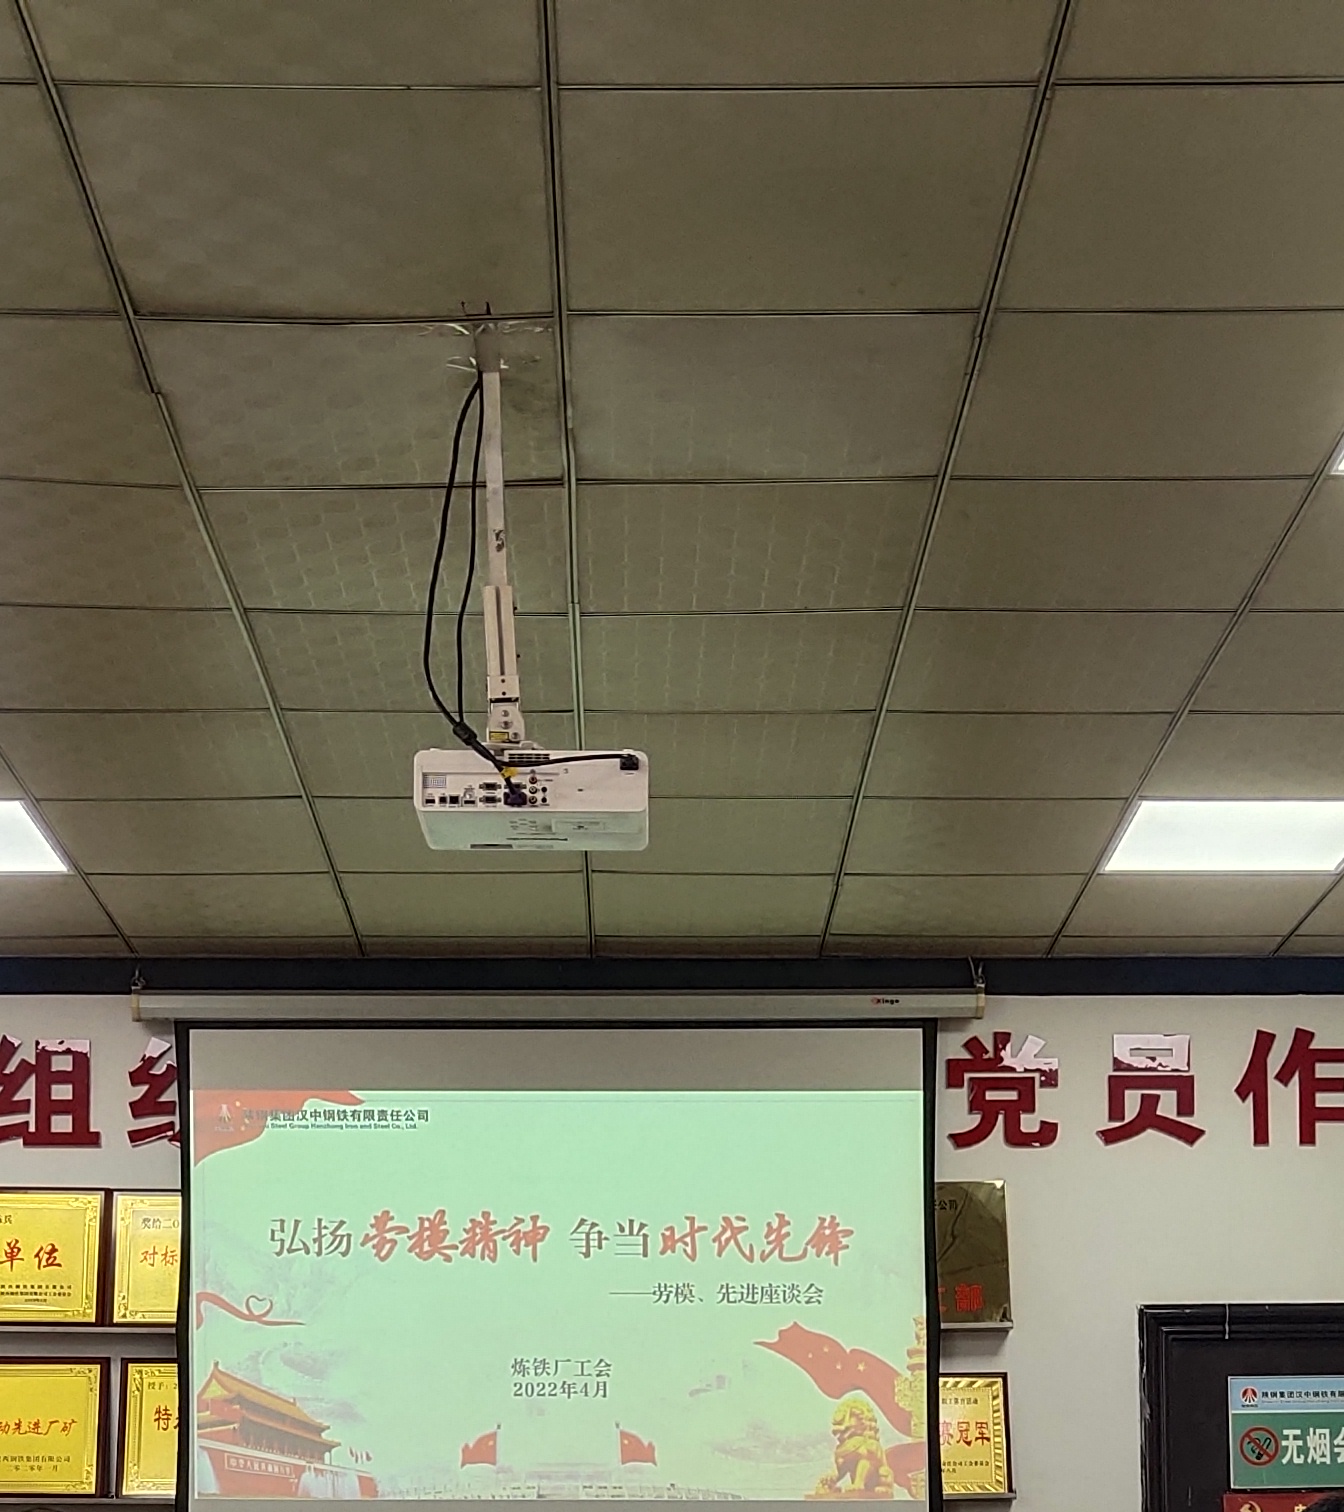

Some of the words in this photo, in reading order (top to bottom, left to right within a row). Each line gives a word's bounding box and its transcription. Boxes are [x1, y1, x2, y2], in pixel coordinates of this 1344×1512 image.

[269, 1209, 550, 1263] 弘扬劳模精神
[569, 1212, 854, 1266] 争当时代先锋
[510, 1357, 613, 1378] 炼铁厂工会
[512, 1380, 609, 1400] 2022年4月
